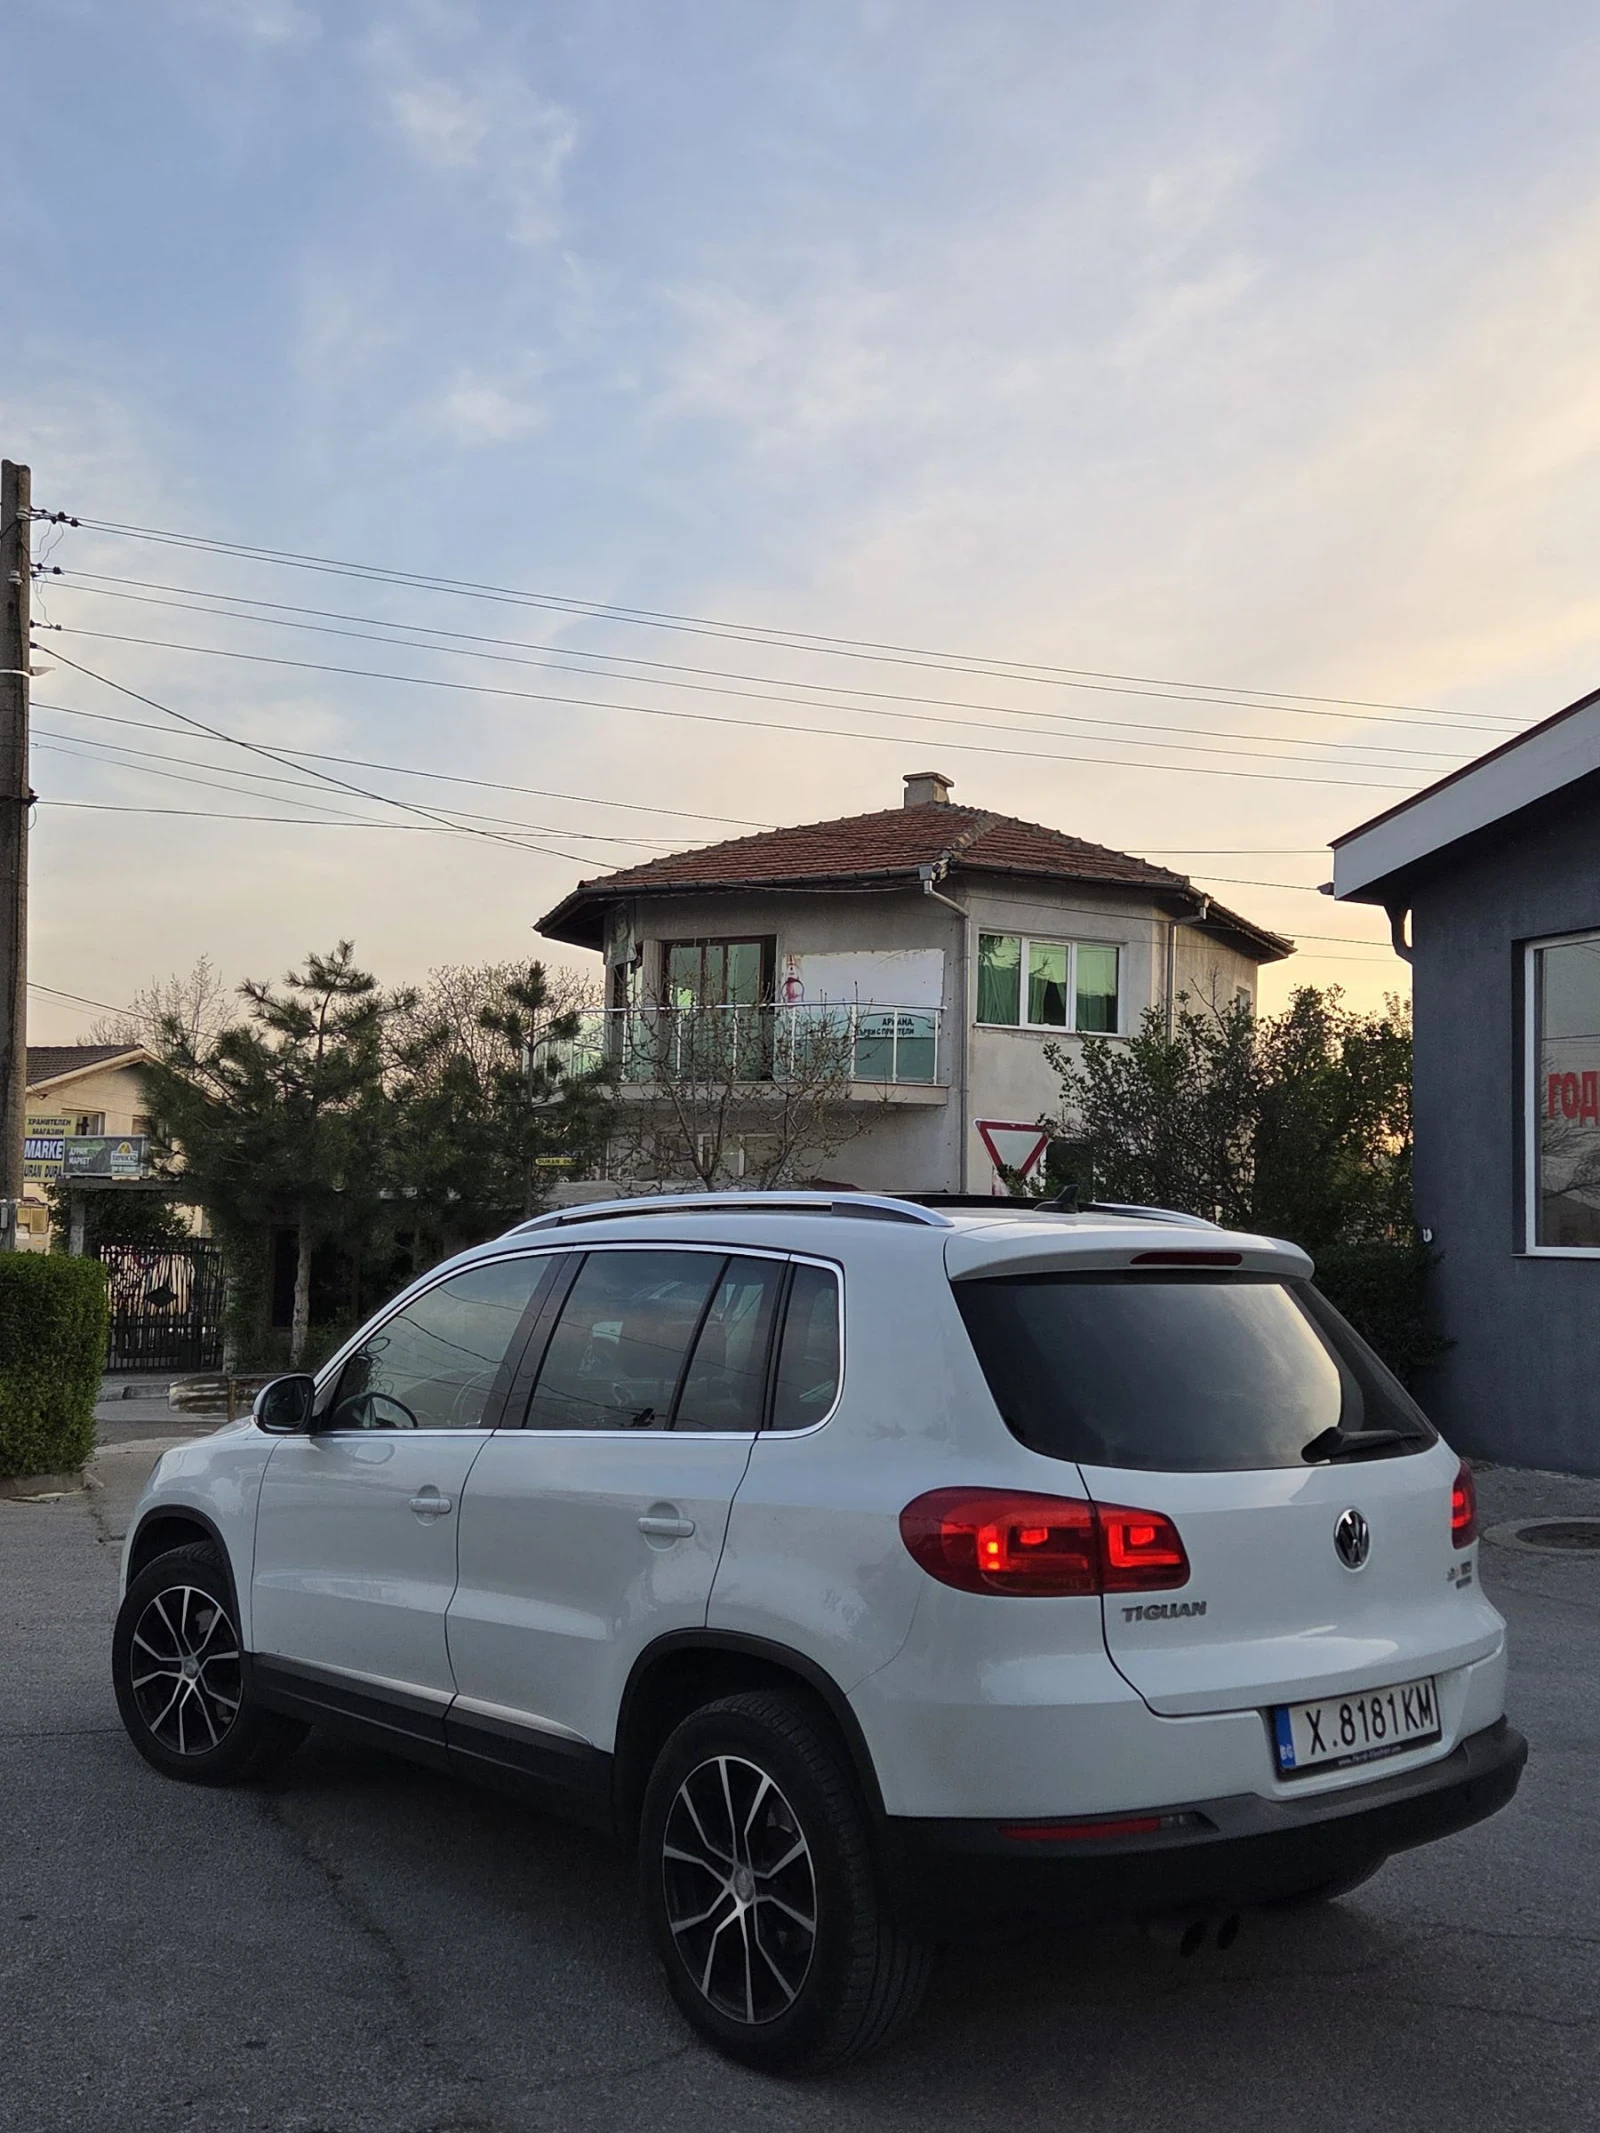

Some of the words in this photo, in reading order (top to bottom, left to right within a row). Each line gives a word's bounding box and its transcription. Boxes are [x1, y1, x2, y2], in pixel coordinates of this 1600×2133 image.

[1548, 1071, 1600, 1128] ГОД
[28, 1118, 71, 1126] ХРАНИТЕЛЕН
[24, 1140, 64, 1159] MARKE
[69, 1157, 91, 1165] МАРКЕТ
[24, 1165, 42, 1178] URAN
[45, 1165, 63, 1178] DURA
[1122, 1601, 1207, 1623] TIGUAN
